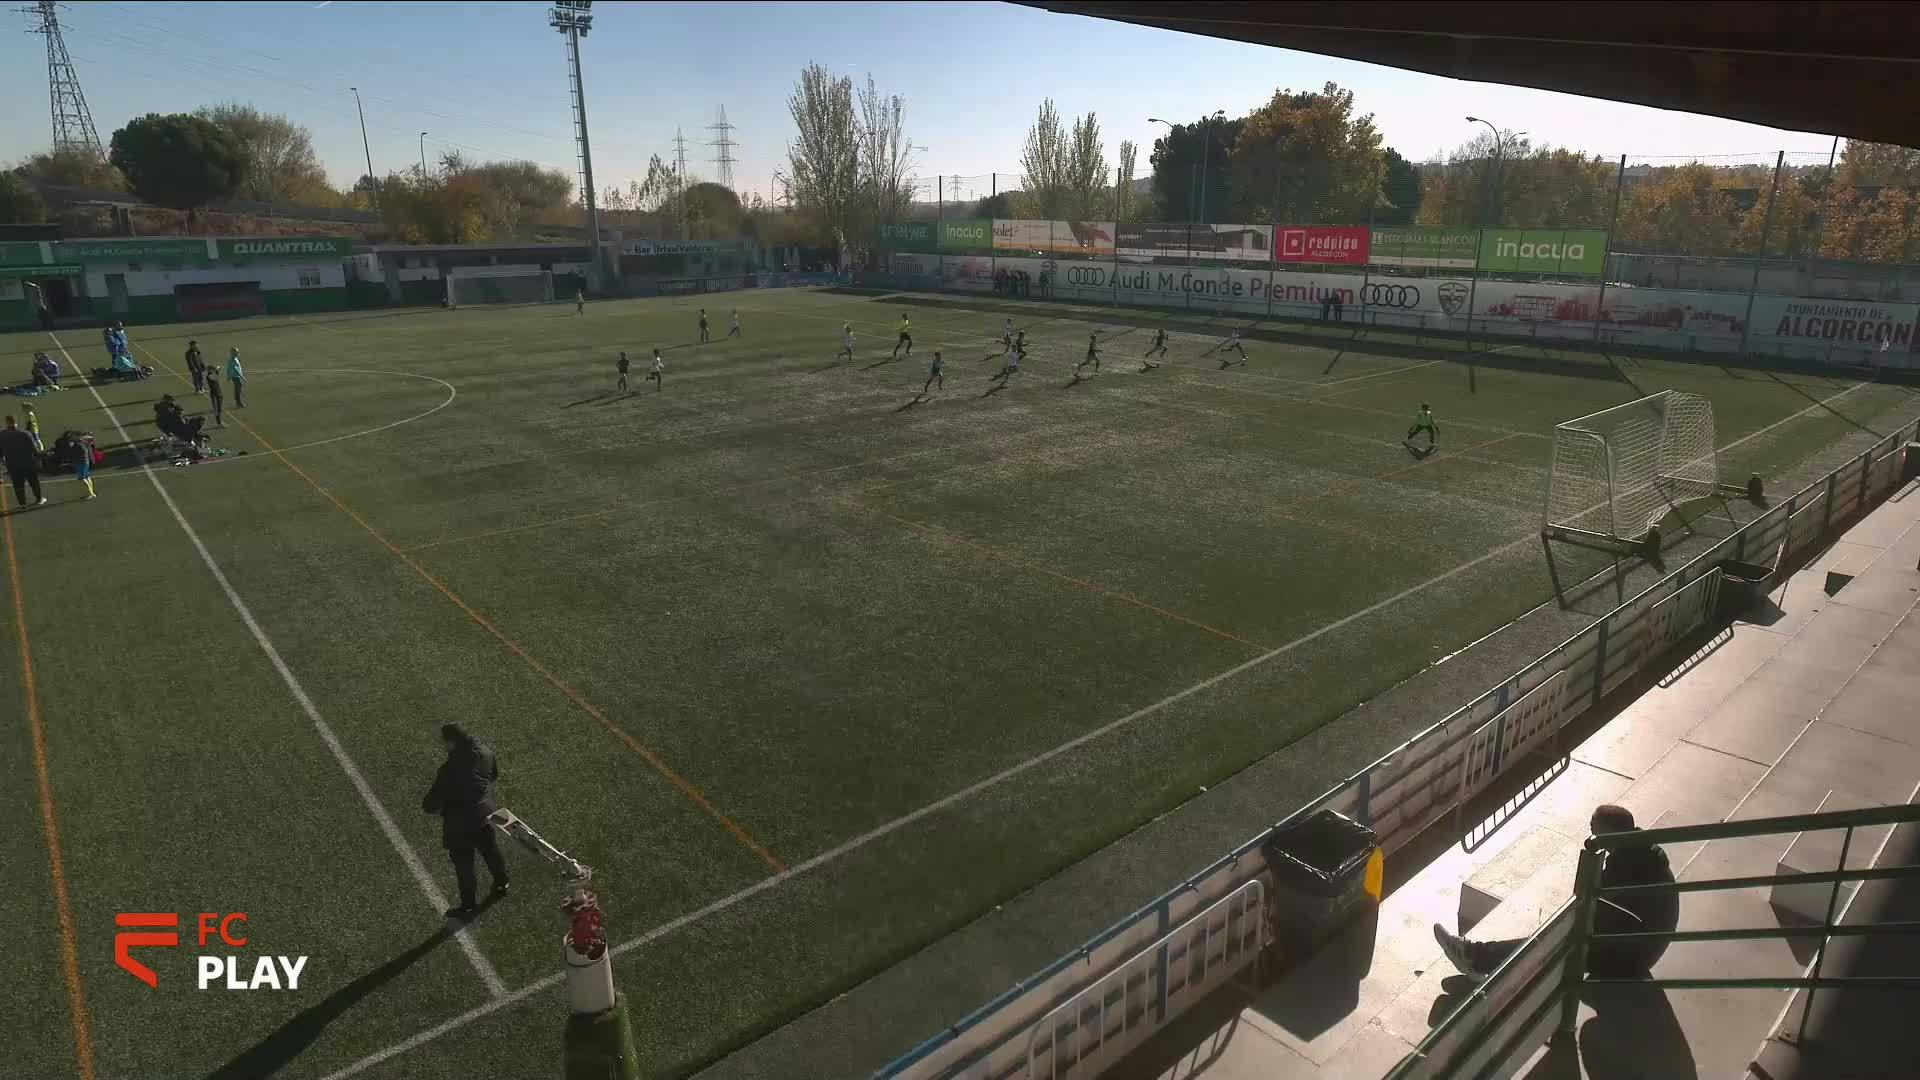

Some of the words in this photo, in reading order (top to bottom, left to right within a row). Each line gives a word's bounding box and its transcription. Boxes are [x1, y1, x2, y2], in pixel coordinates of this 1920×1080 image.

[1496, 237, 1584, 259] inacua
[1108, 270, 1150, 290] Audi
[1786, 304, 1865, 318] AYUNTAMIENTO
[1869, 308, 1885, 319] DE
